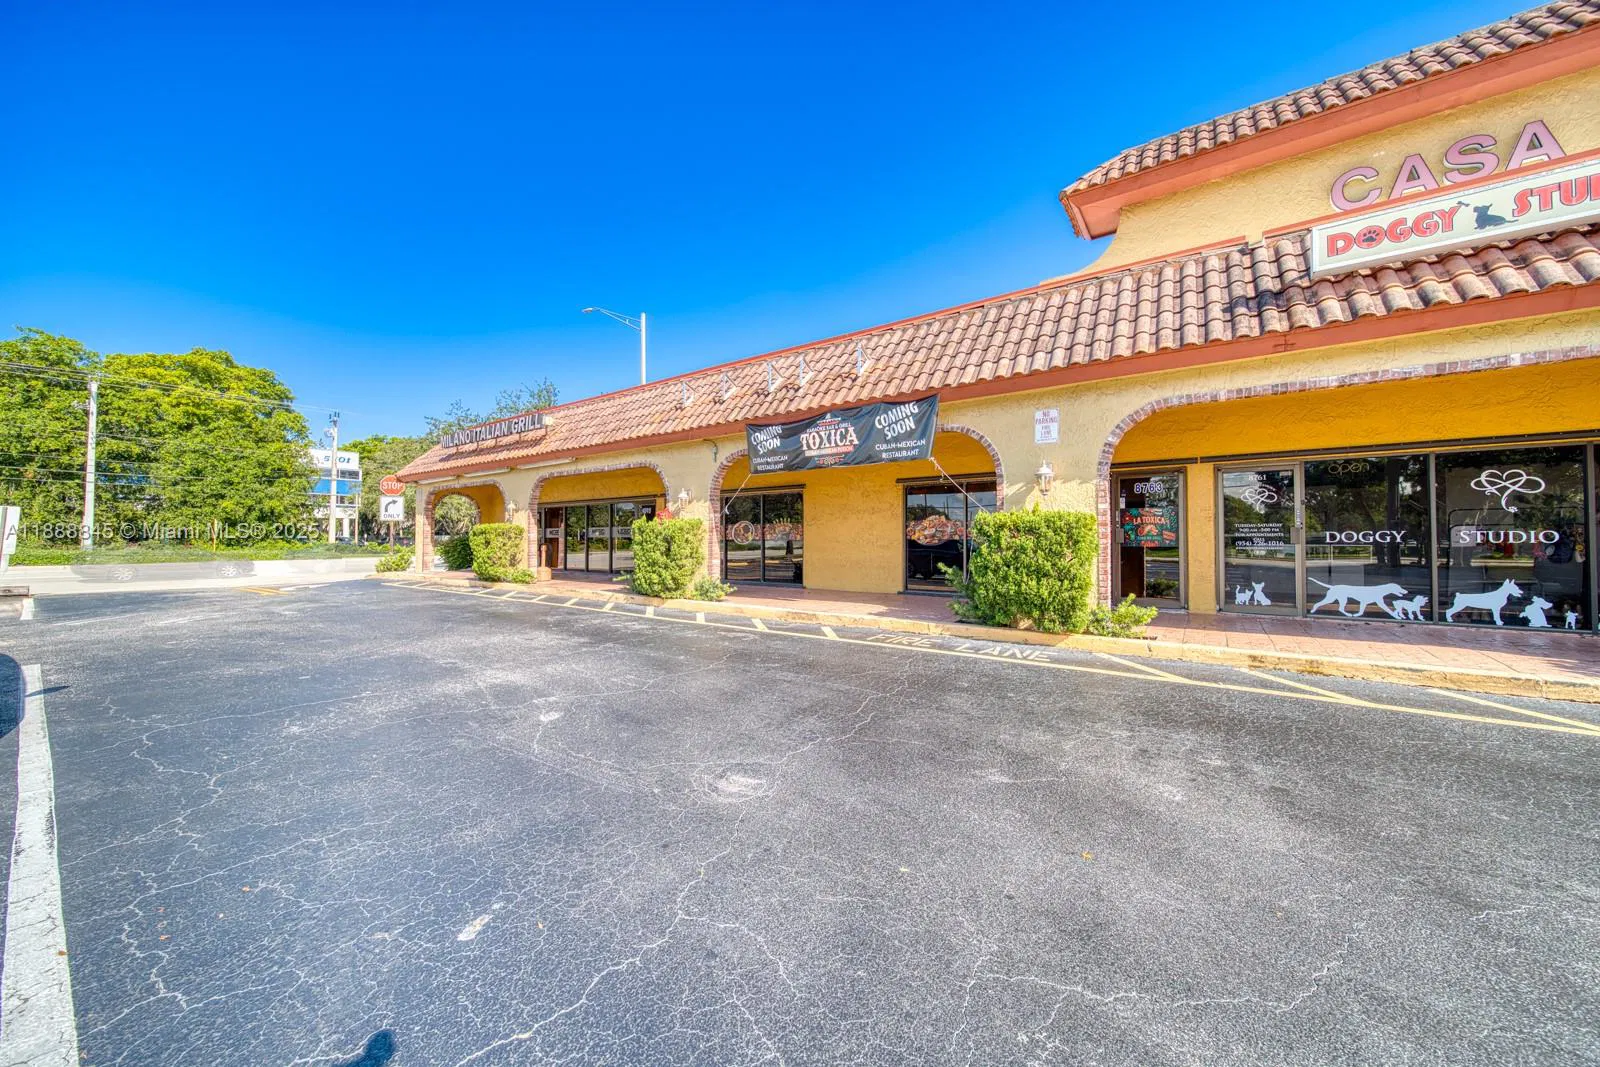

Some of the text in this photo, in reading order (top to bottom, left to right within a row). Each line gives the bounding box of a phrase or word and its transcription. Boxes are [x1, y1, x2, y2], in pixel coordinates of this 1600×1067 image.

[1330, 119, 1567, 212] CASA
[1327, 204, 1462, 257] DOGGY
[875, 401, 919, 429] COMING
[1036, 416, 1057, 424] PARKING
[440, 414, 541, 448] MILANO ITALIAN GRILL
[751, 425, 783, 445] COMING
[884, 416, 916, 440] SOON
[757, 436, 781, 454] SOON
[800, 426, 859, 450] TOXICA
[875, 438, 926, 450] CUBAN-MEXICAN
[882, 448, 919, 458] RESTAURANT
[1328, 463, 1369, 475] open
[381, 482, 403, 490] STOP
[1134, 482, 1163, 493] 8763
[1142, 515, 1166, 525] TOXICA
[1325, 530, 1560, 544] DOGGY STUDIO
[866, 633, 1059, 662] FIRE LANE
